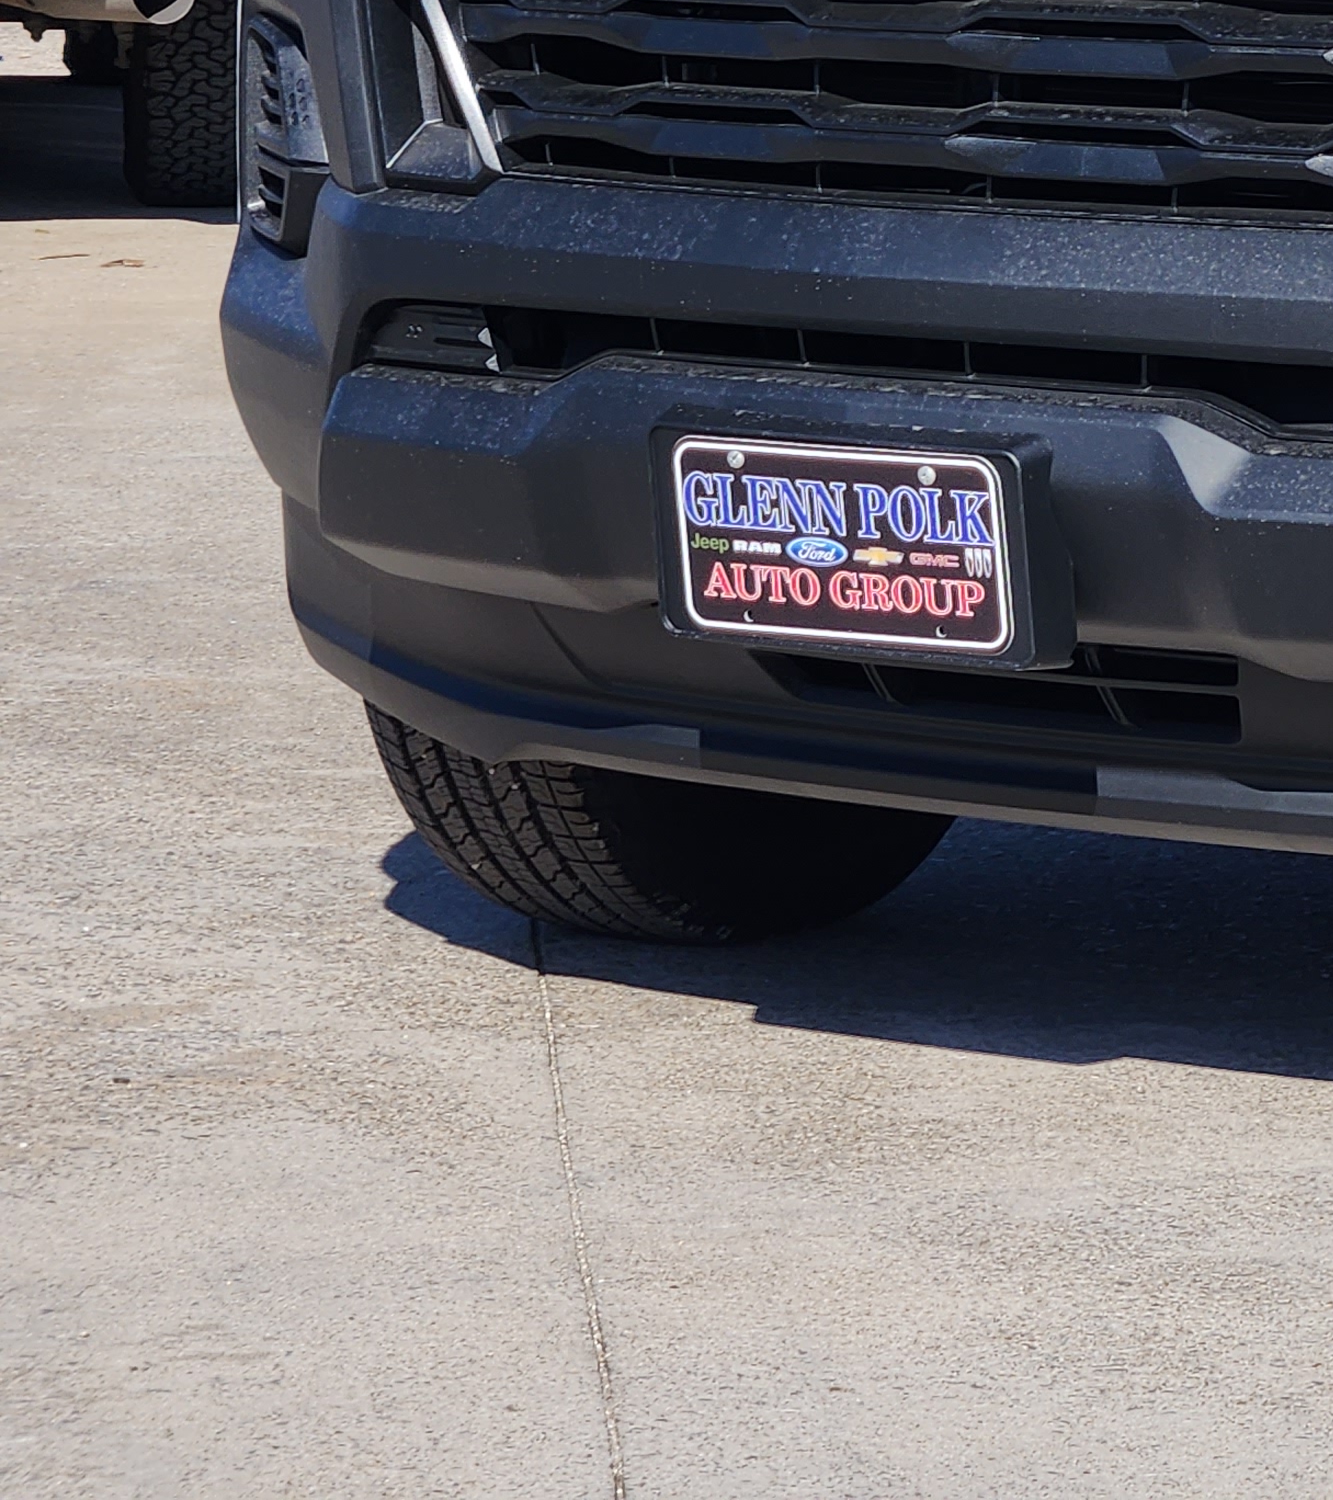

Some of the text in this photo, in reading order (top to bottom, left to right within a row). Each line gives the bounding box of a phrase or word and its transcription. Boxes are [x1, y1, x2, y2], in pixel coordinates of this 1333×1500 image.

[683, 471, 996, 547] GLENN POLK
[690, 532, 960, 568] Jeep RAM Ford GMC
[703, 561, 985, 618] AUTO GROUP
